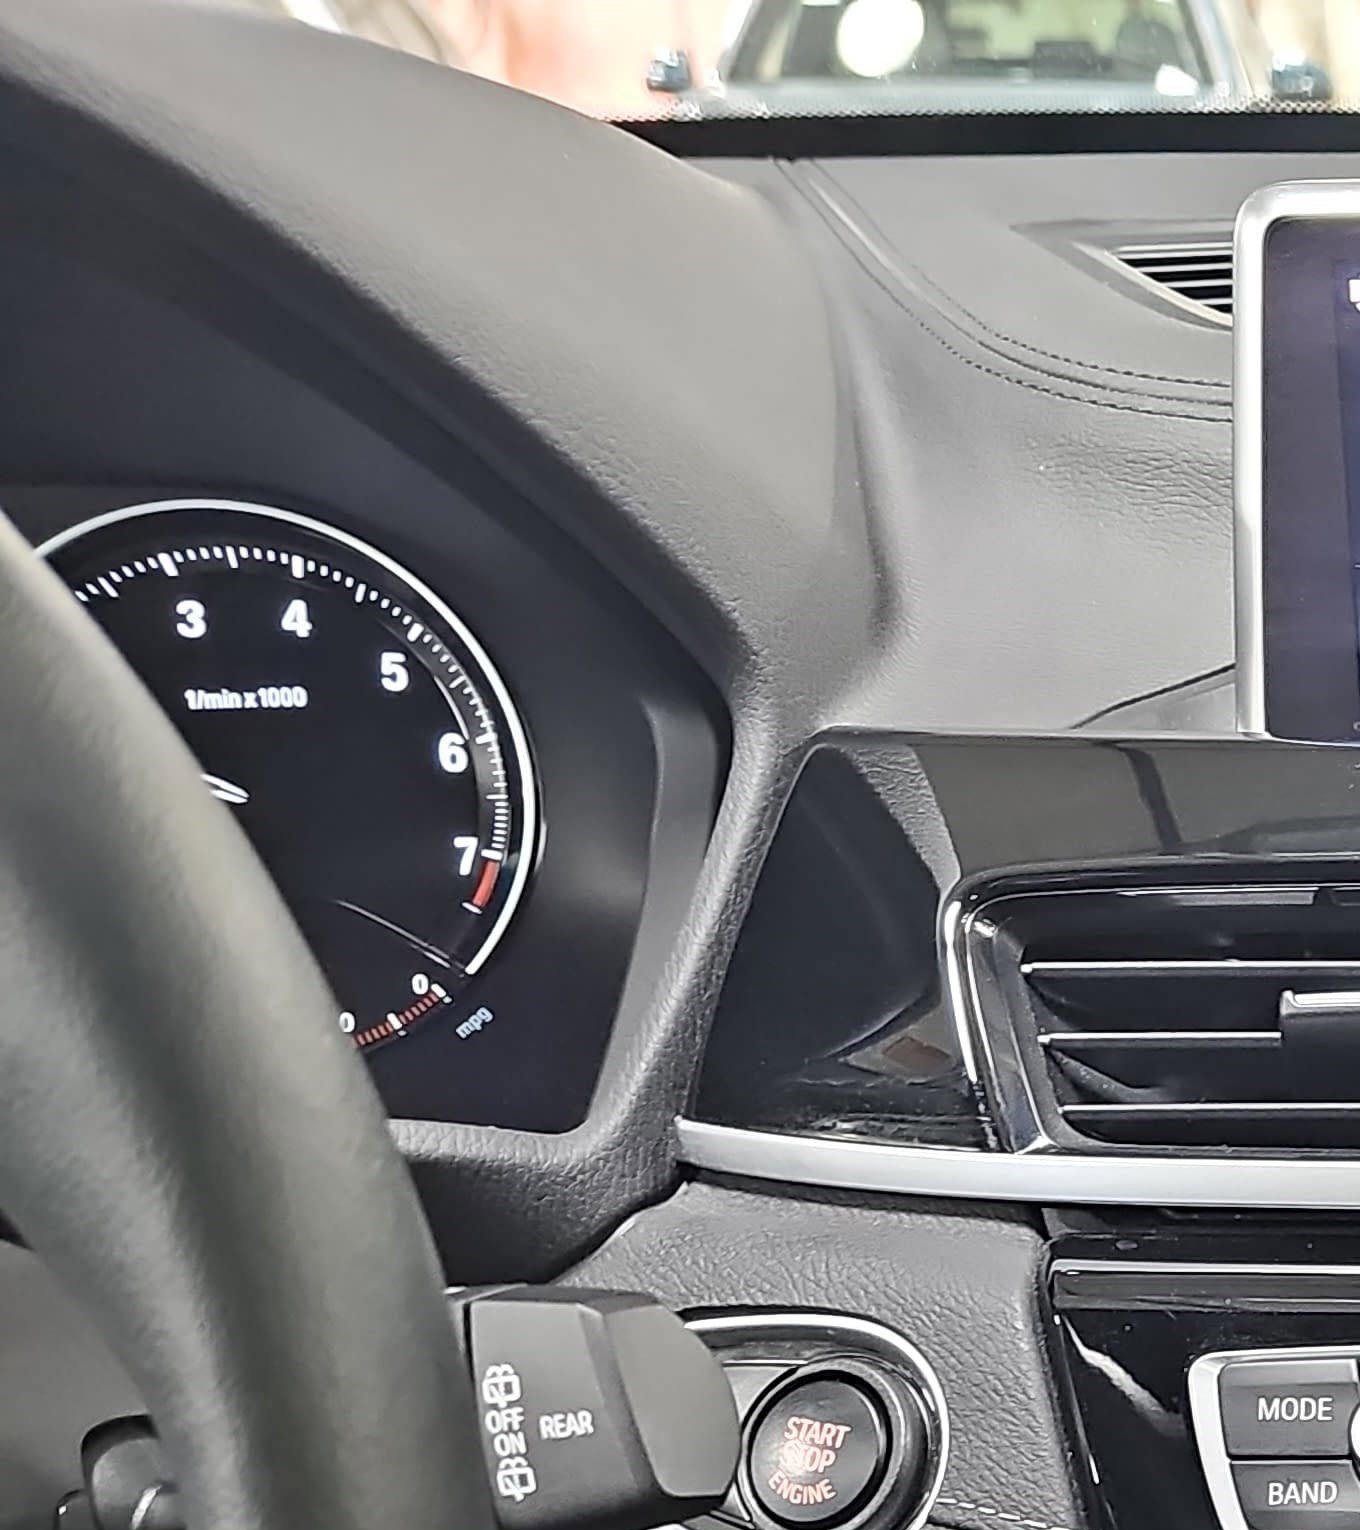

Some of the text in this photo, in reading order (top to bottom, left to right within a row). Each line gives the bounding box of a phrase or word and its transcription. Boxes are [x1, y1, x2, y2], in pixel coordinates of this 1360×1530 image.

[175, 599, 208, 638] 3
[281, 599, 313, 638] 4
[380, 651, 409, 692] 5
[438, 732, 469, 773] 6
[453, 836, 479, 876] 7
[411, 973, 429, 995] 0
[455, 1007, 494, 1039] mpg
[485, 1406, 525, 1434] OFF
[539, 1410, 594, 1439] REAR
[1257, 1397, 1333, 1421] MODE
[494, 1431, 527, 1457] ON
[784, 1416, 852, 1449] START
[780, 1440, 836, 1473] STOP
[768, 1470, 837, 1505] ENGINE
[1267, 1481, 1338, 1506] BAND
